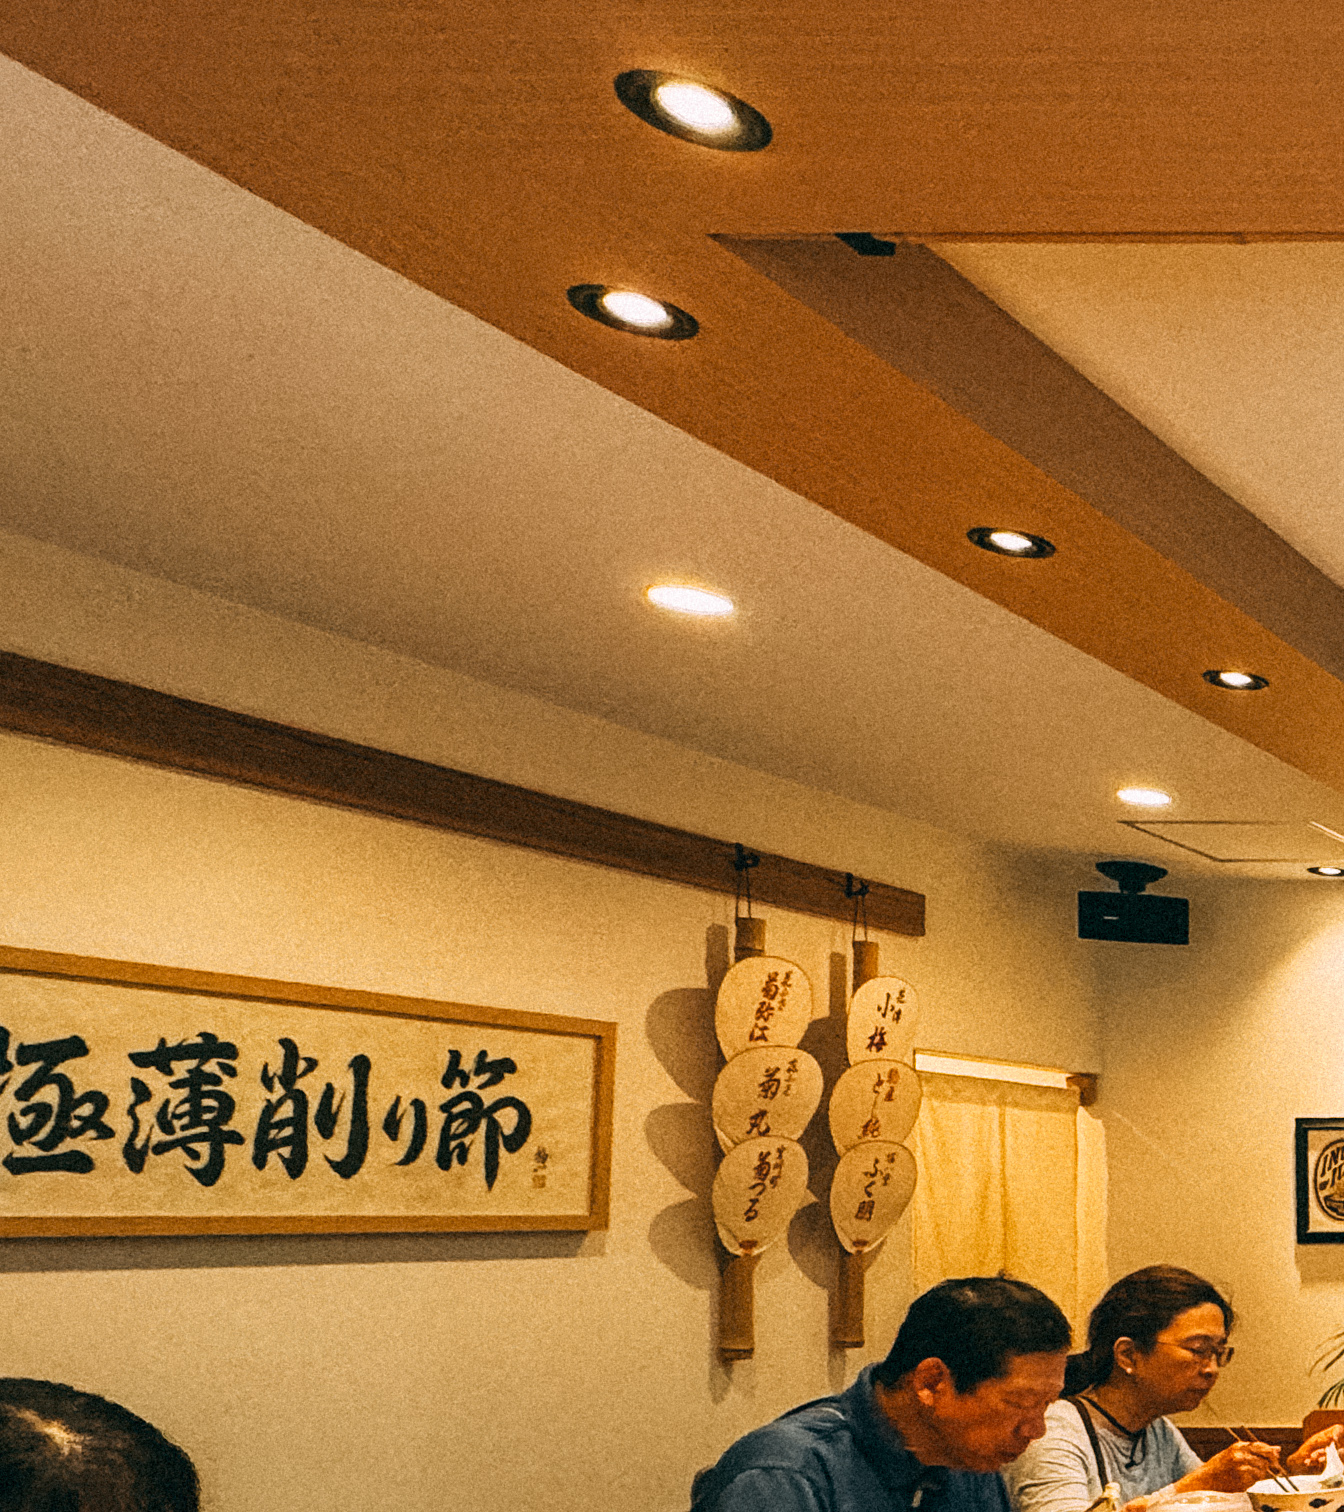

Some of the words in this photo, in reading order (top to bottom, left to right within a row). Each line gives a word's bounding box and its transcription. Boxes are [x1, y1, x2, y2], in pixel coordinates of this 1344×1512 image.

[0, 1026, 533, 1192] 極薄削り節
